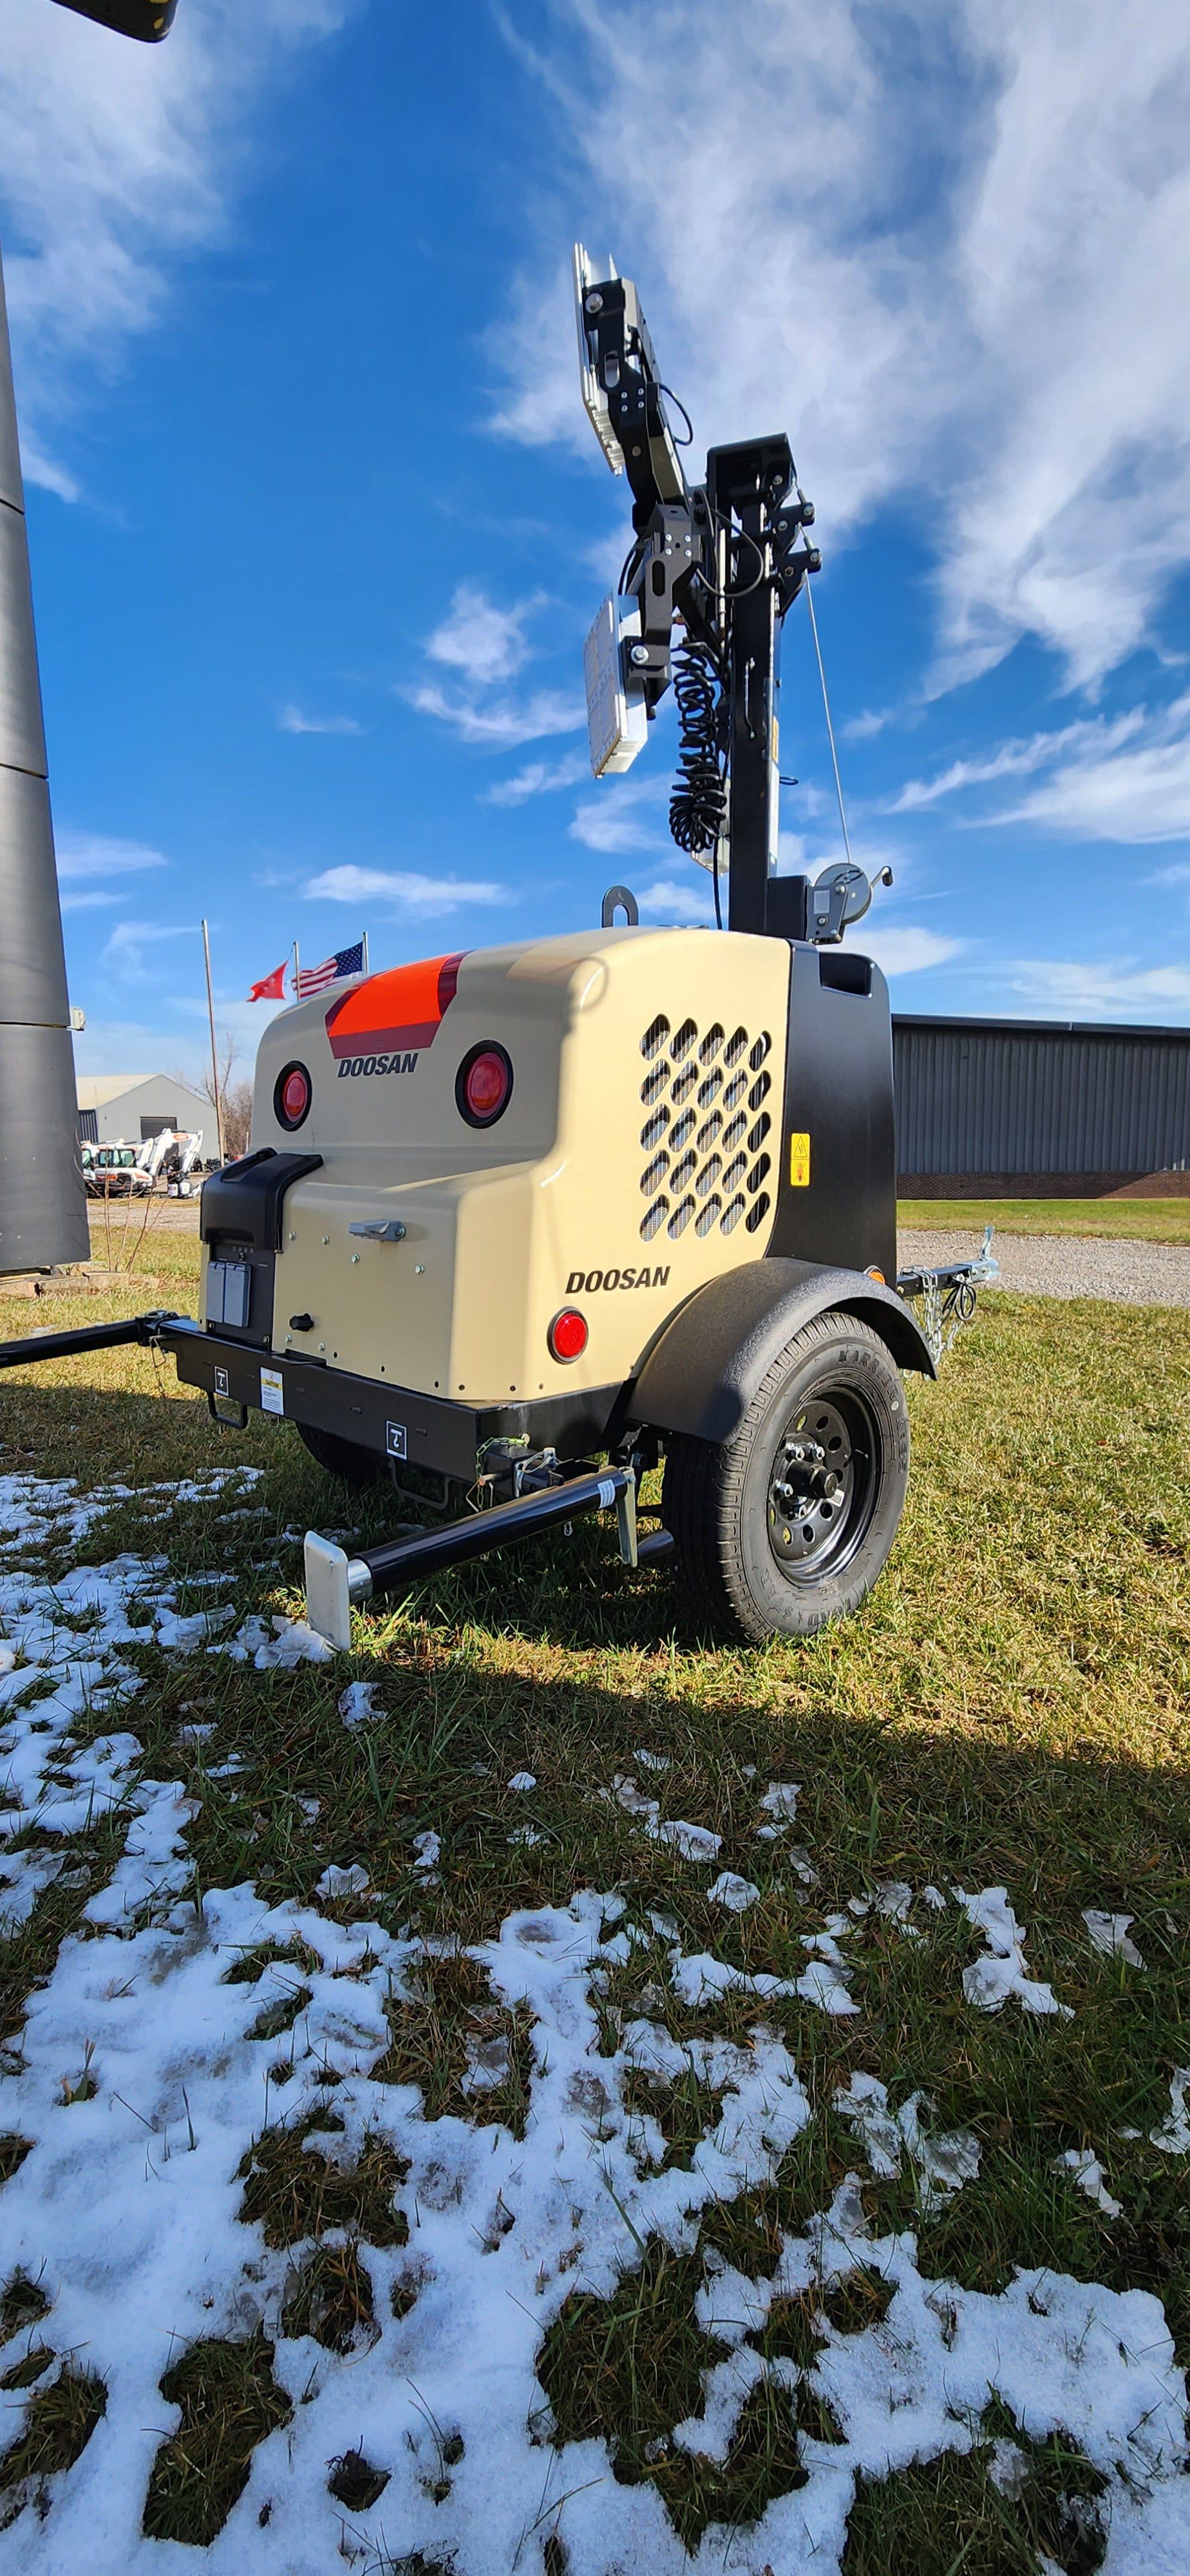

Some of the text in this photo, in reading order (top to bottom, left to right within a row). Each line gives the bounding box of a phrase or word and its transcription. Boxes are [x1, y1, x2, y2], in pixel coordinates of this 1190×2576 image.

[337, 1053, 419, 1077] DOOSAN
[565, 1265, 671, 1294] DOOSAN
[838, 1350, 898, 1401] KARRIER
